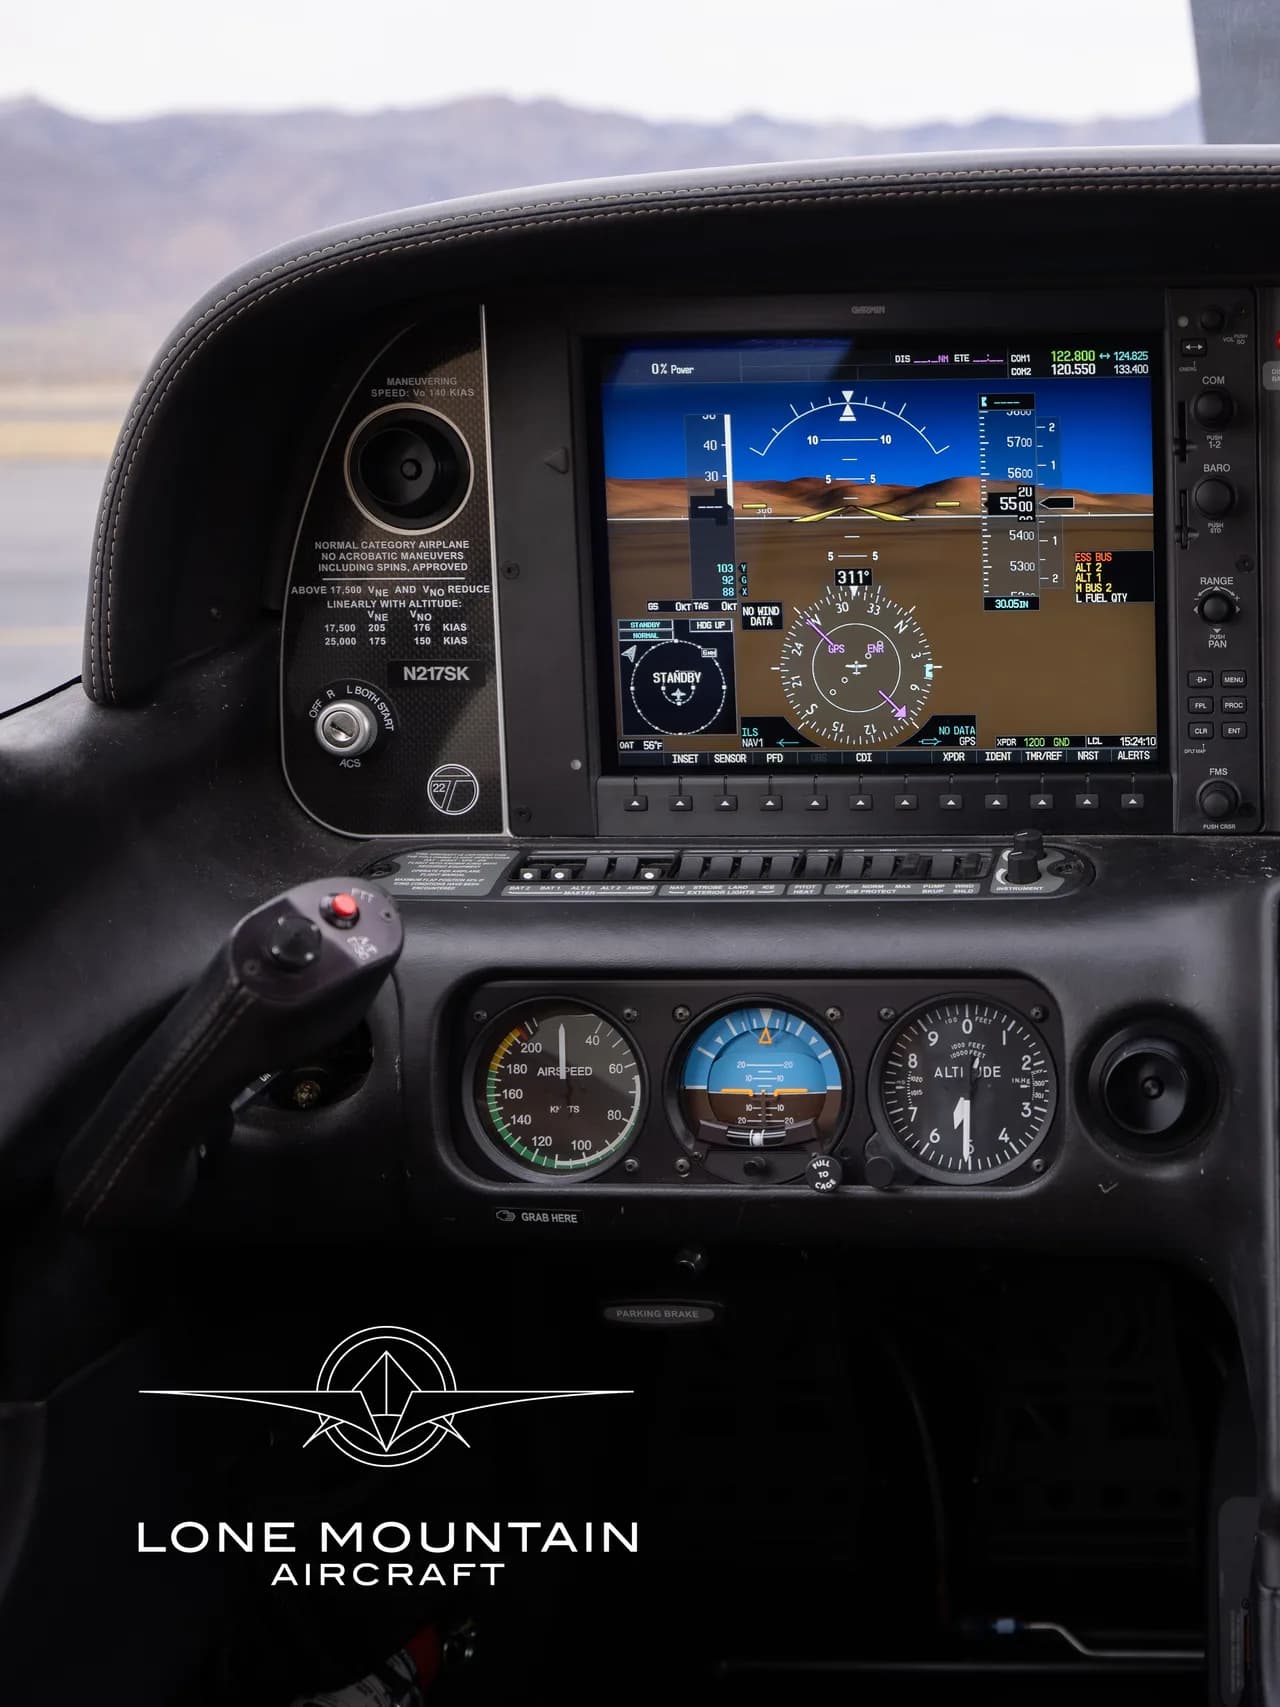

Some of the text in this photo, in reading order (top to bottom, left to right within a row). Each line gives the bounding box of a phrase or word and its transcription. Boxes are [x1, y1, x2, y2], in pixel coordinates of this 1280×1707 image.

[1011, 354, 1030, 363] COM1
[1052, 350, 1095, 362] 122.800
[651, 364, 694, 374] 0% Power
[1011, 364, 1148, 376] COM2 120.550 133.400
[1202, 376, 1225, 385] COM
[371, 389, 409, 397] SPEED:
[430, 389, 446, 397] 140
[1007, 437, 1032, 447] 5700
[1203, 464, 1230, 472] BARO
[1009, 531, 1034, 540] 5400
[315, 541, 469, 549] NORMAL CATEGORY AIRPLANE
[322, 552, 464, 560] NO ACROBATIC MANEUVERS
[1075, 553, 1112, 561] ESS BUS
[319, 563, 468, 572] INCLUDING SPINS, APPROVED
[1200, 577, 1233, 585] RANGE
[291, 586, 327, 594] ABOVE
[331, 586, 361, 594] 17,500
[395, 586, 416, 594] AND
[448, 585, 490, 593] REDUCE
[1076, 593, 1127, 603] L FUEL QTY
[327, 600, 462, 608] LINEARLY WITH ALTITUDE:
[743, 607, 779, 616] NO WIND
[697, 621, 725, 630] HDG UP
[751, 618, 772, 626] DATA
[324, 624, 356, 632] 17,500
[325, 637, 468, 646] 25,000 175 150 KIAS
[1208, 640, 1227, 648] PAN
[403, 667, 470, 681] N217SK
[653, 672, 701, 683] STANDBY
[309, 686, 394, 731] OFF R L BOTH START
[939, 726, 975, 735] NO DATA
[742, 738, 763, 747] NAV1
[959, 736, 975, 746] GPS
[997, 737, 1156, 747] XPDR 1200 GND LCL 15:24:10
[672, 755, 698, 763] INSET
[714, 754, 746, 763] SENSOR
[767, 754, 783, 763] PFD
[856, 753, 872, 762] CDI
[943, 752, 965, 761] XPDR
[985, 751, 1011, 761] IDENT
[1026, 751, 1062, 761] TMR/REF
[1078, 751, 1099, 760] NRST
[1118, 751, 1150, 760] ALERTS
[340, 759, 360, 768] ACS
[521, 1042, 542, 1053] 200
[507, 1064, 528, 1074] 180
[537, 1066, 592, 1076] AIRSPEED
[609, 1063, 623, 1074] 60
[510, 1114, 532, 1125] 140
[571, 1140, 592, 1151] 100
[521, 1212, 578, 1223] GRAB HERE
[616, 1309, 698, 1319] PARKING BRAKE
